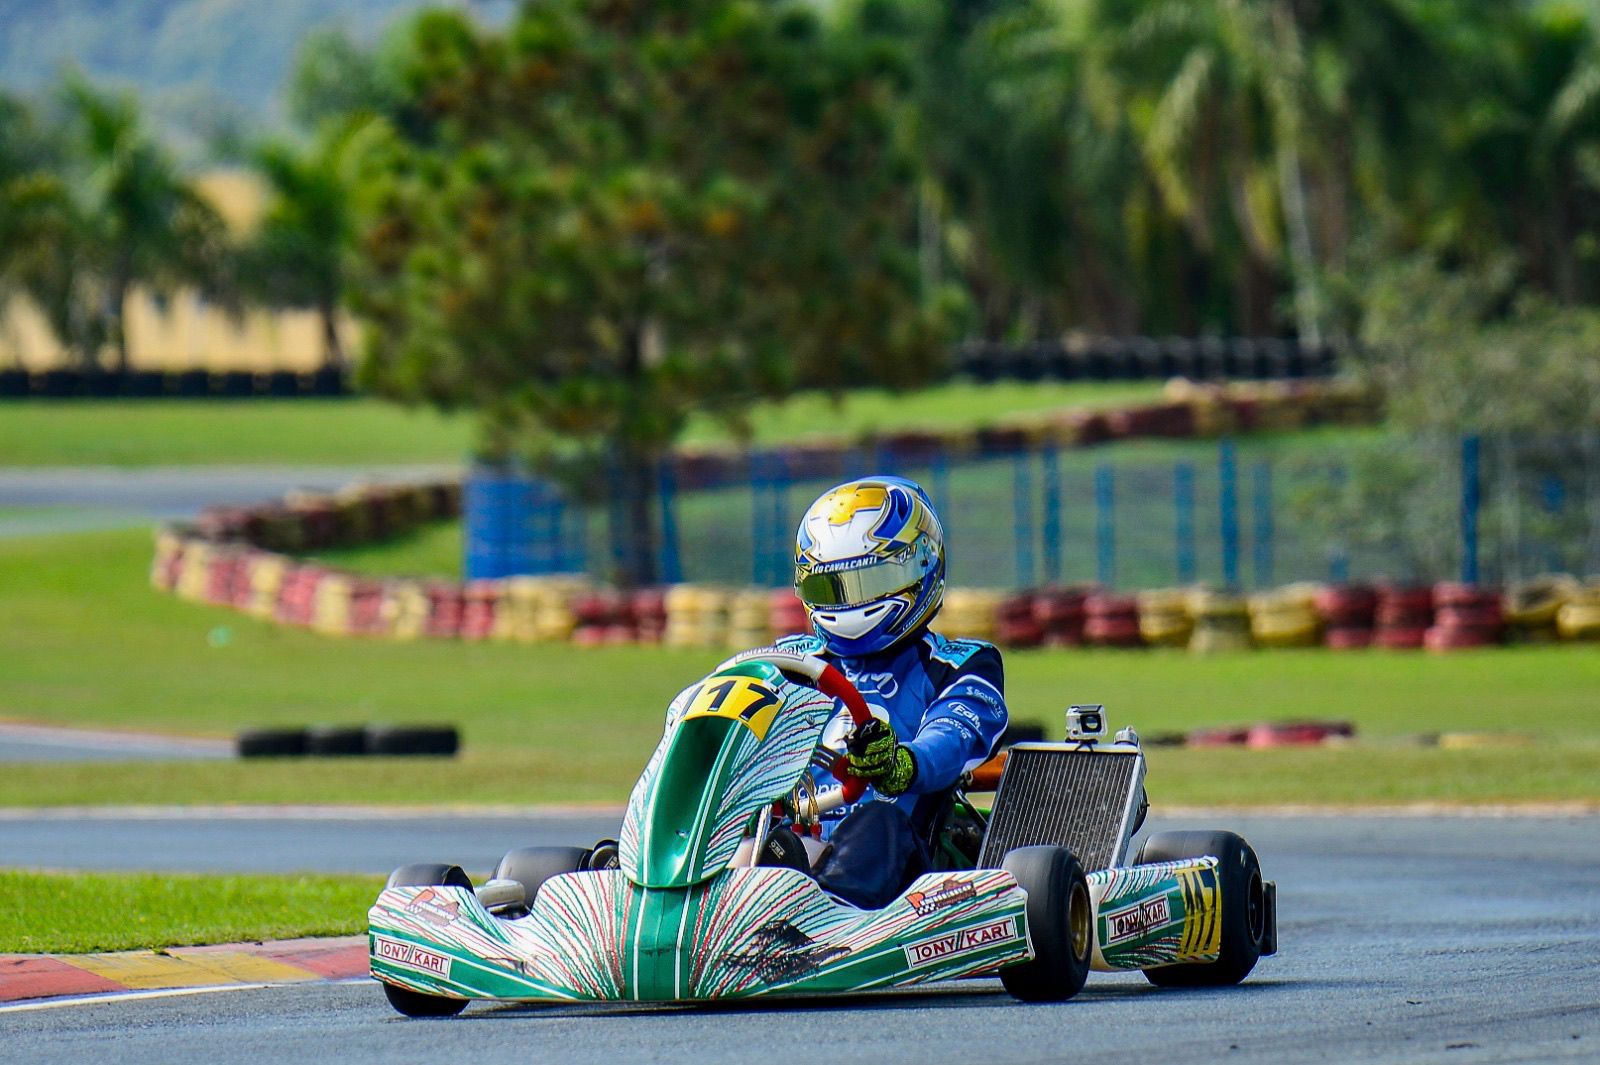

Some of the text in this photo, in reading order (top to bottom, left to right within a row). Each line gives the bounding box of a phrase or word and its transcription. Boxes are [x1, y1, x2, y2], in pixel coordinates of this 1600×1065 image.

[824, 555, 878, 574] CAVALCANTI
[942, 645, 971, 657] OMP
[681, 680, 779, 721] 117
[770, 841, 785, 859] OMP
[1109, 898, 1167, 936] TONY KART
[379, 939, 448, 972] TONY KART
[910, 920, 1011, 960] TONY KART
